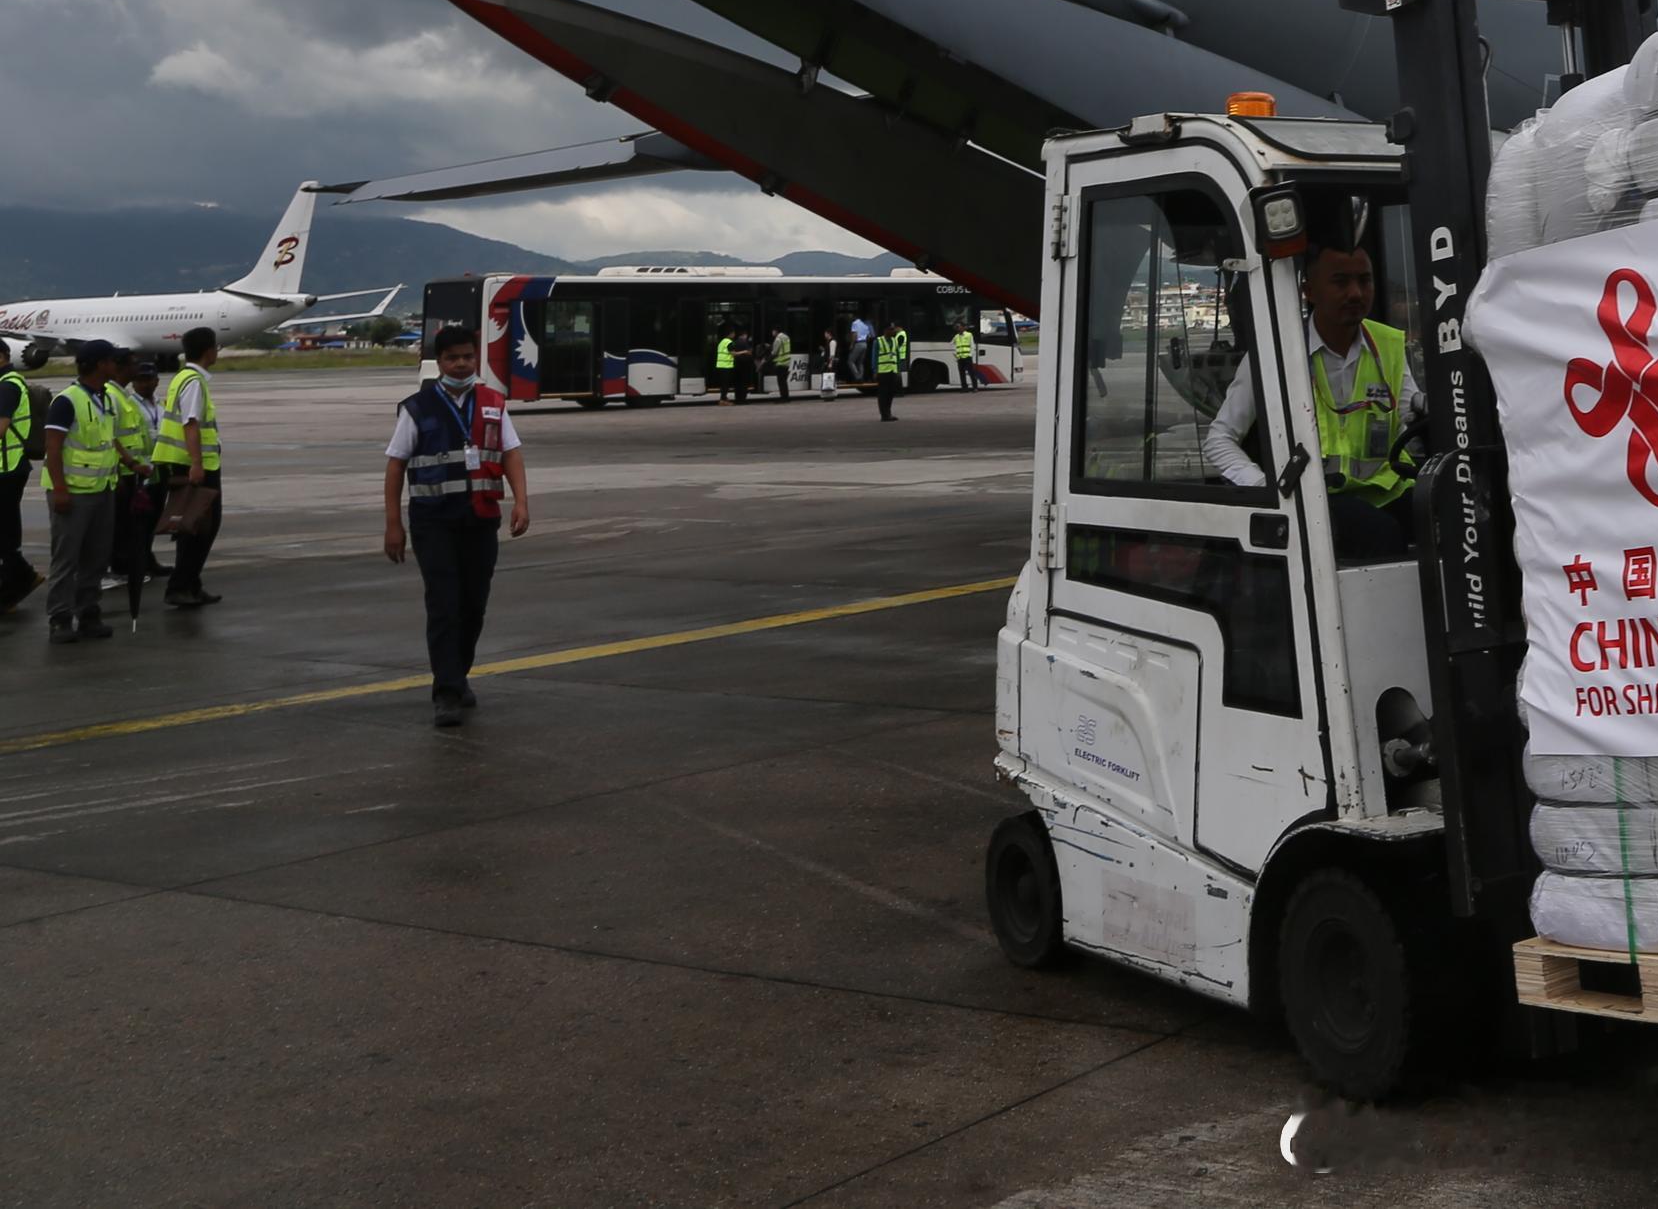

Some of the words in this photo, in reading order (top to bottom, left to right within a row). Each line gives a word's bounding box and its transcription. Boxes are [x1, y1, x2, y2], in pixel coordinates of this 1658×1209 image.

[936, 285, 964, 294] COBUS
[1430, 226, 1462, 354] BYD
[1462, 492, 1479, 563] Your
[1576, 686, 1621, 717] FOR
[1074, 747, 1107, 768] ELECTRIC
[1107, 761, 1141, 782] FORKLIFT
